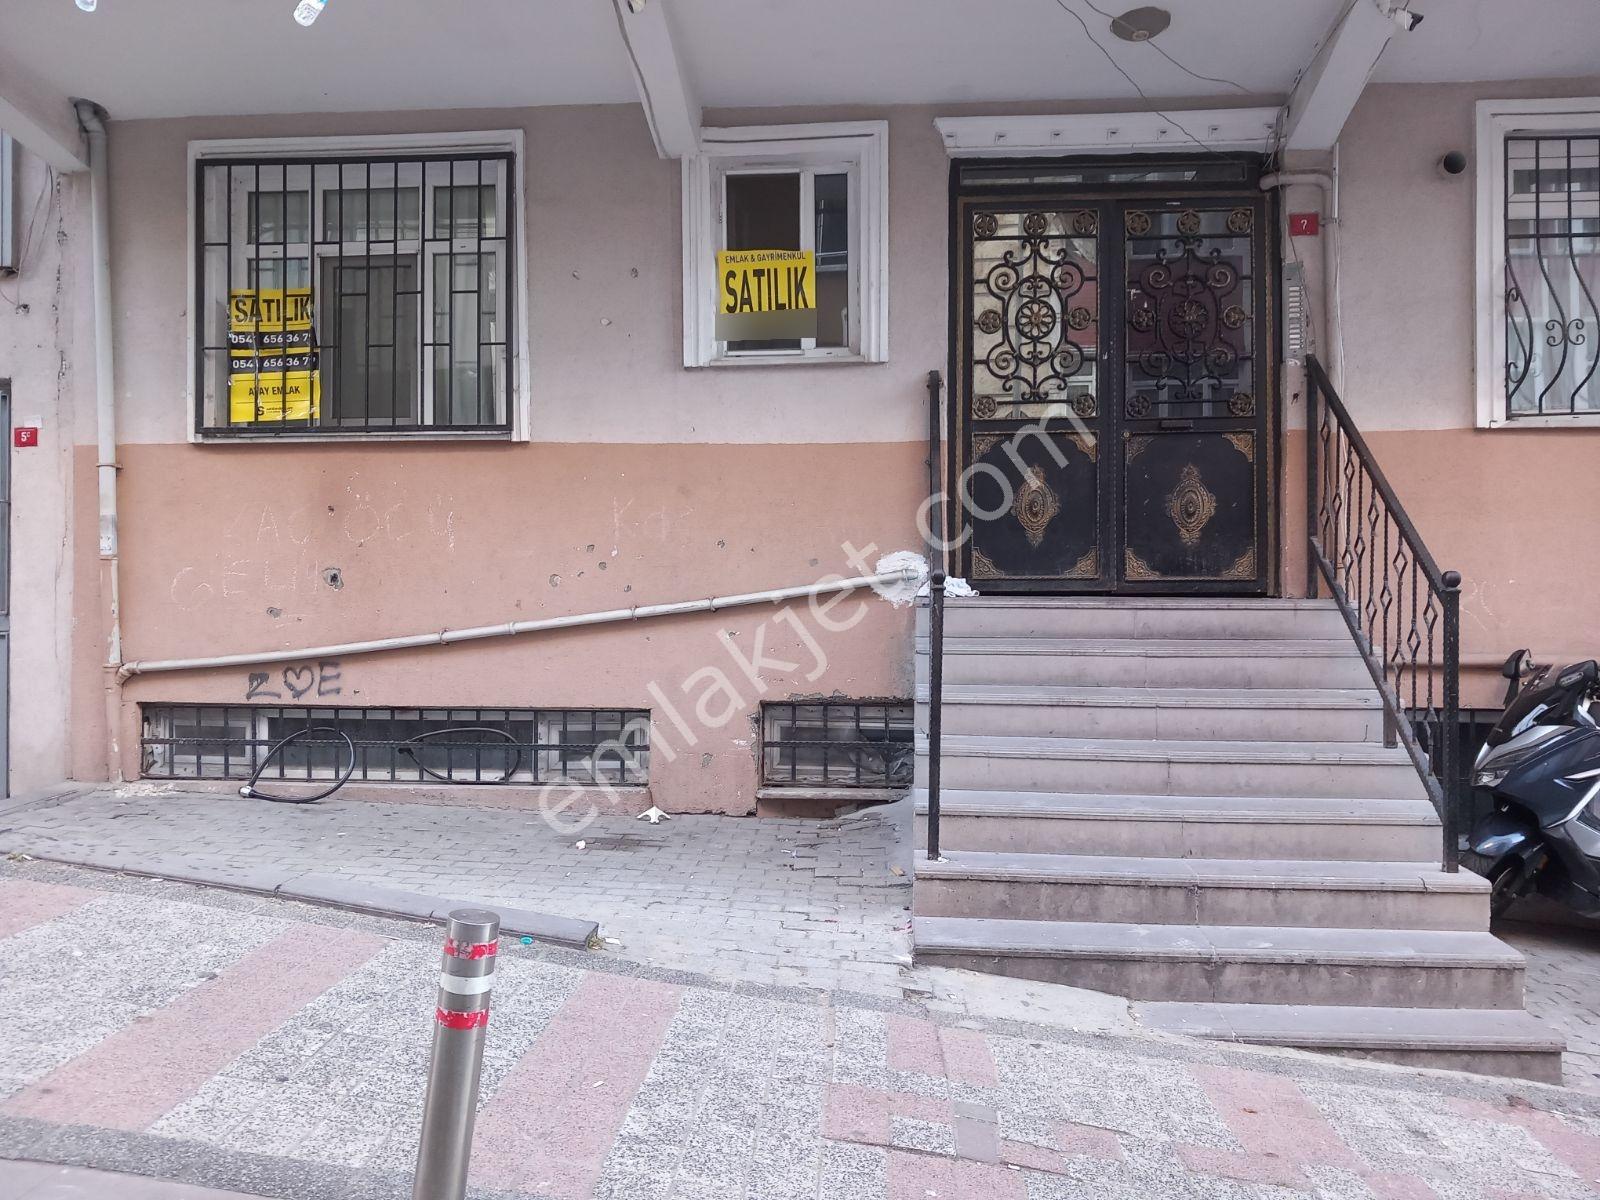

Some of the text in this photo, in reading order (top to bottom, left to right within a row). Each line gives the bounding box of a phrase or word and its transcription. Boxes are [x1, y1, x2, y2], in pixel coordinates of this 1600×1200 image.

[725, 254, 749, 264] EMLAK
[751, 253, 756, 263] &
[725, 266, 808, 313] SATILIK
[231, 334, 256, 344] 054
[263, 334, 284, 344] 656
[286, 333, 300, 343] 36
[232, 359, 255, 369] 054
[263, 358, 284, 368] 656
[286, 357, 300, 367] 36
[249, 386, 270, 397] AAY
